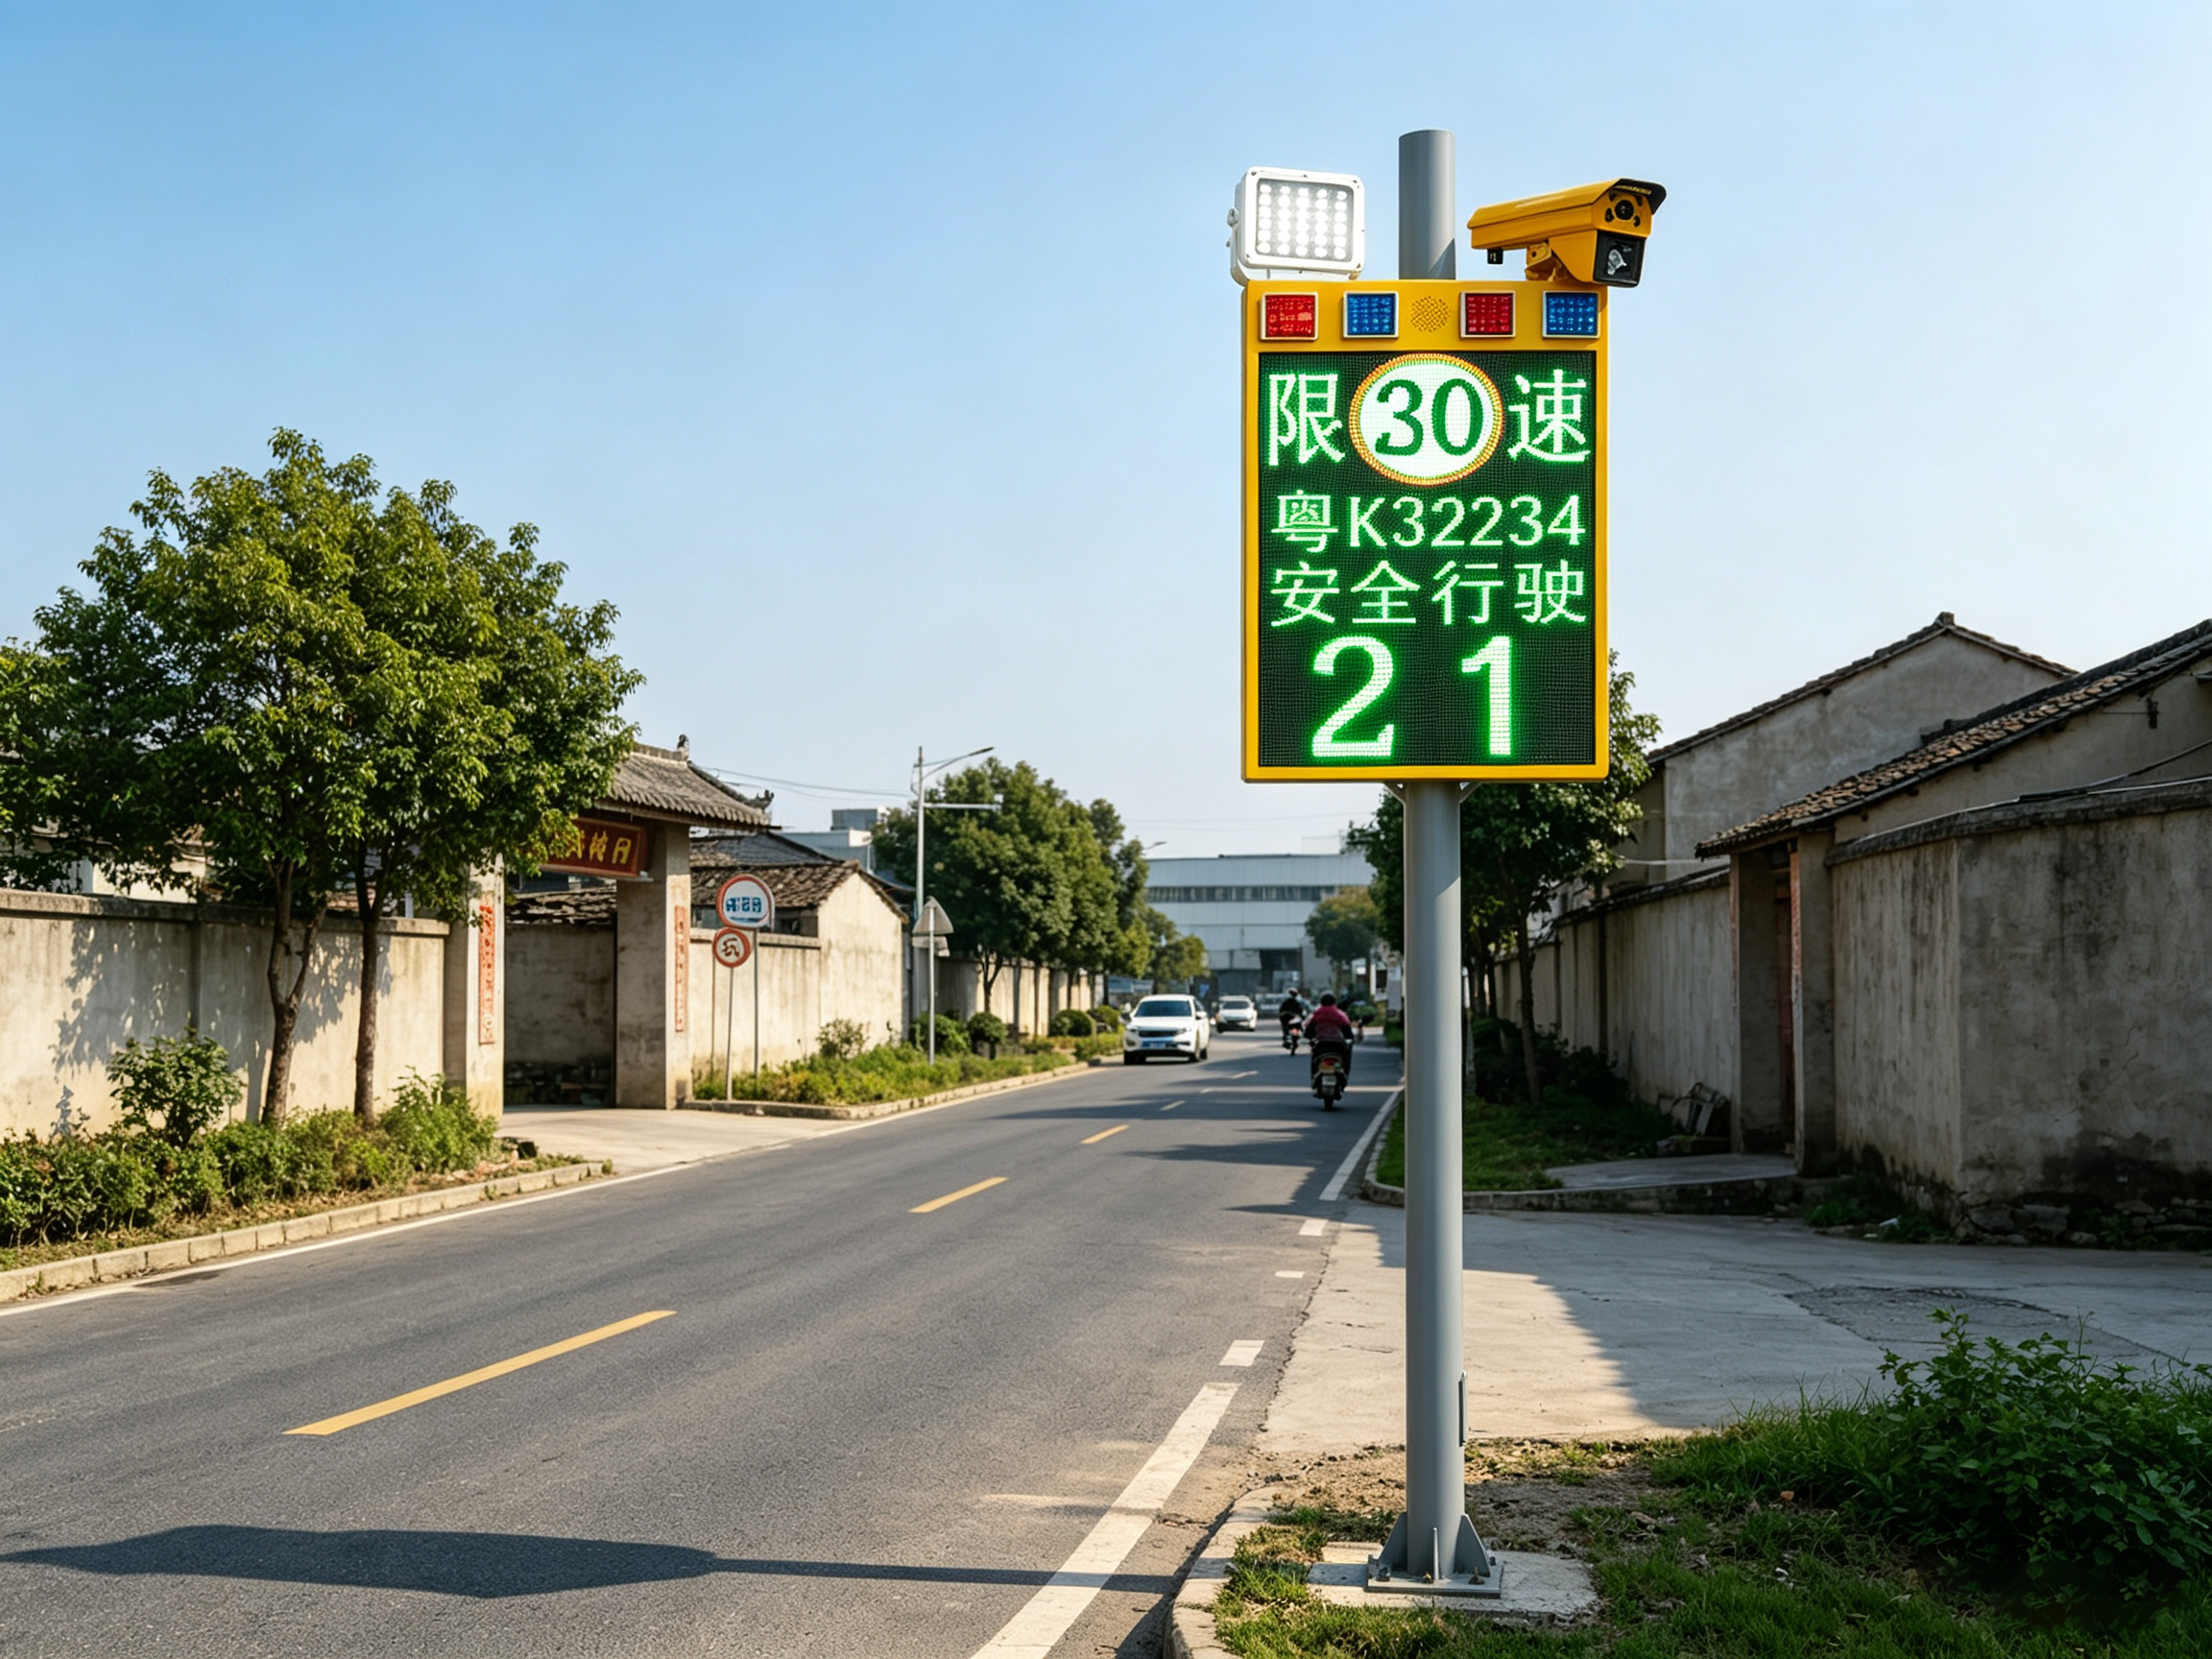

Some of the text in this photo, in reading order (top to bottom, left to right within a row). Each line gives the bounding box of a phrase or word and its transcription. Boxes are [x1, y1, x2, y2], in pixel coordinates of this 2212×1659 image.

[1268, 369, 1591, 467] 限 30 速
[1270, 489, 1586, 552] 粤K32234
[1270, 559, 1586, 627] 安全行驶
